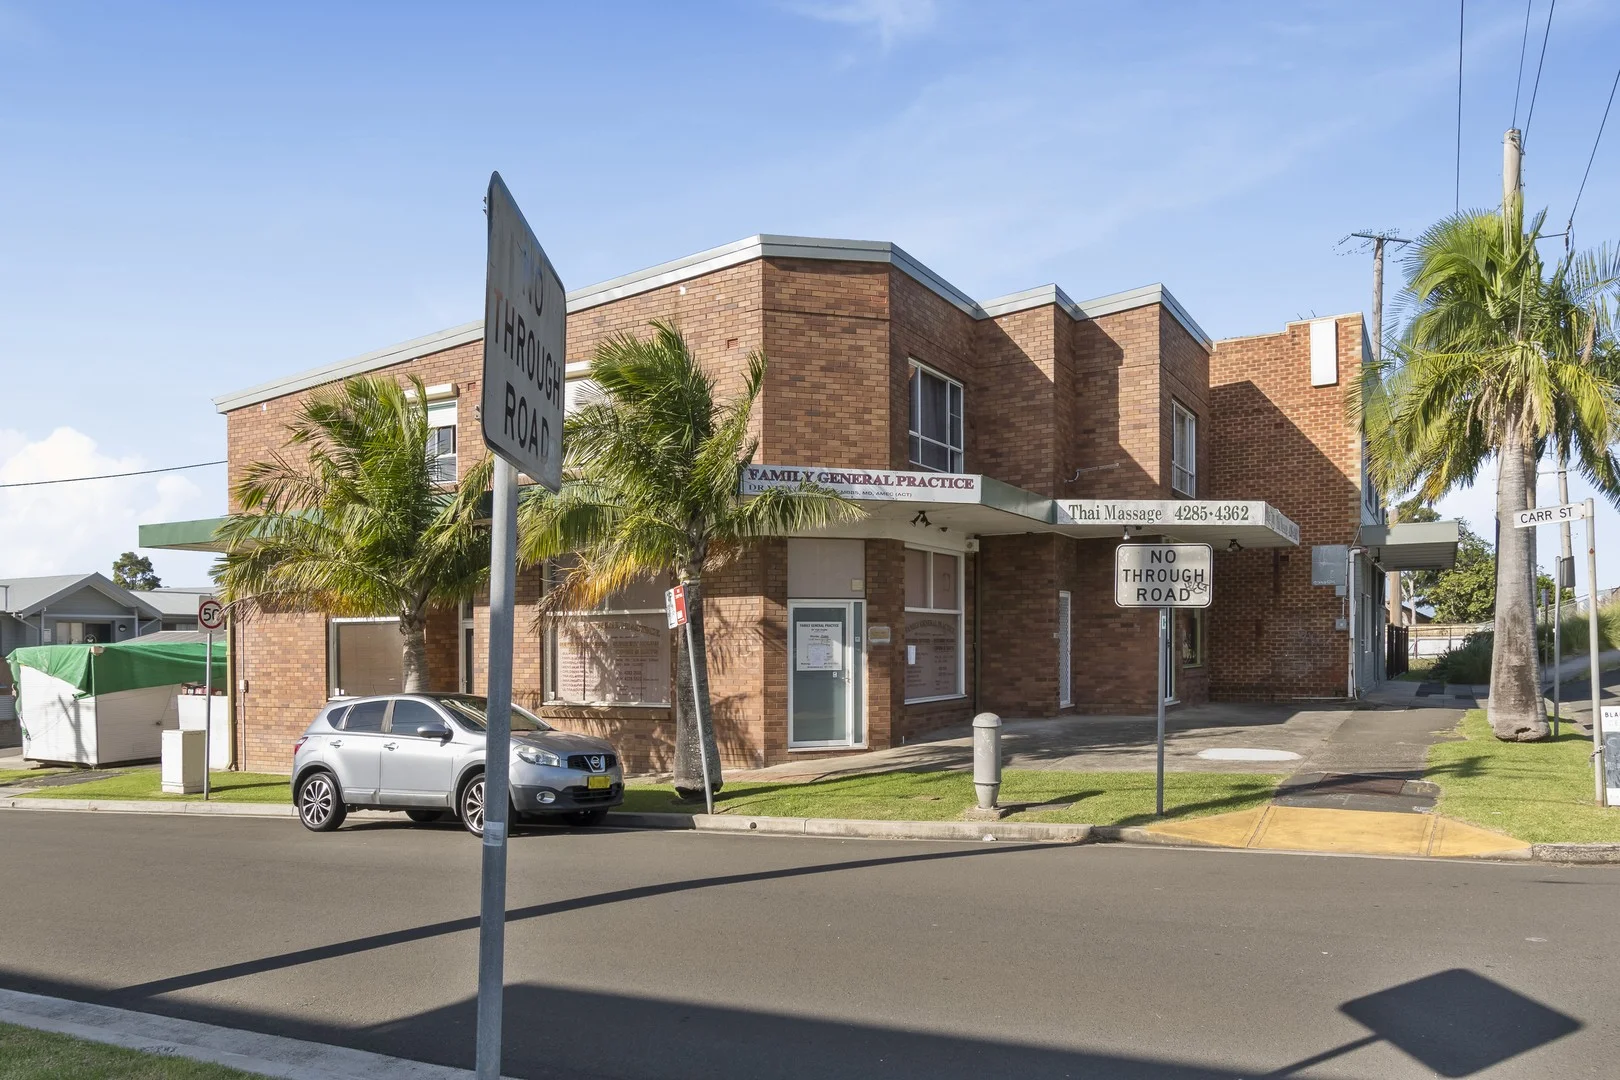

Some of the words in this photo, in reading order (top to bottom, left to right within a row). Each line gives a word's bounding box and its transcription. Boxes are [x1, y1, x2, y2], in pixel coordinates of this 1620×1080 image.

[494, 289, 561, 411] THROUGH
[504, 381, 550, 465] ROAD
[748, 467, 815, 483] FAMILY
[817, 471, 894, 486] GENERAL
[896, 475, 975, 490] PRACTICE
[1069, 504, 1100, 521] Thai
[1104, 504, 1162, 524] Massage
[1520, 510, 1552, 524] CARR
[1559, 507, 1573, 518] ST
[1151, 550, 1177, 564] NO
[1123, 568, 1204, 583] THROUGH
[1136, 587, 1191, 601] ROAD
